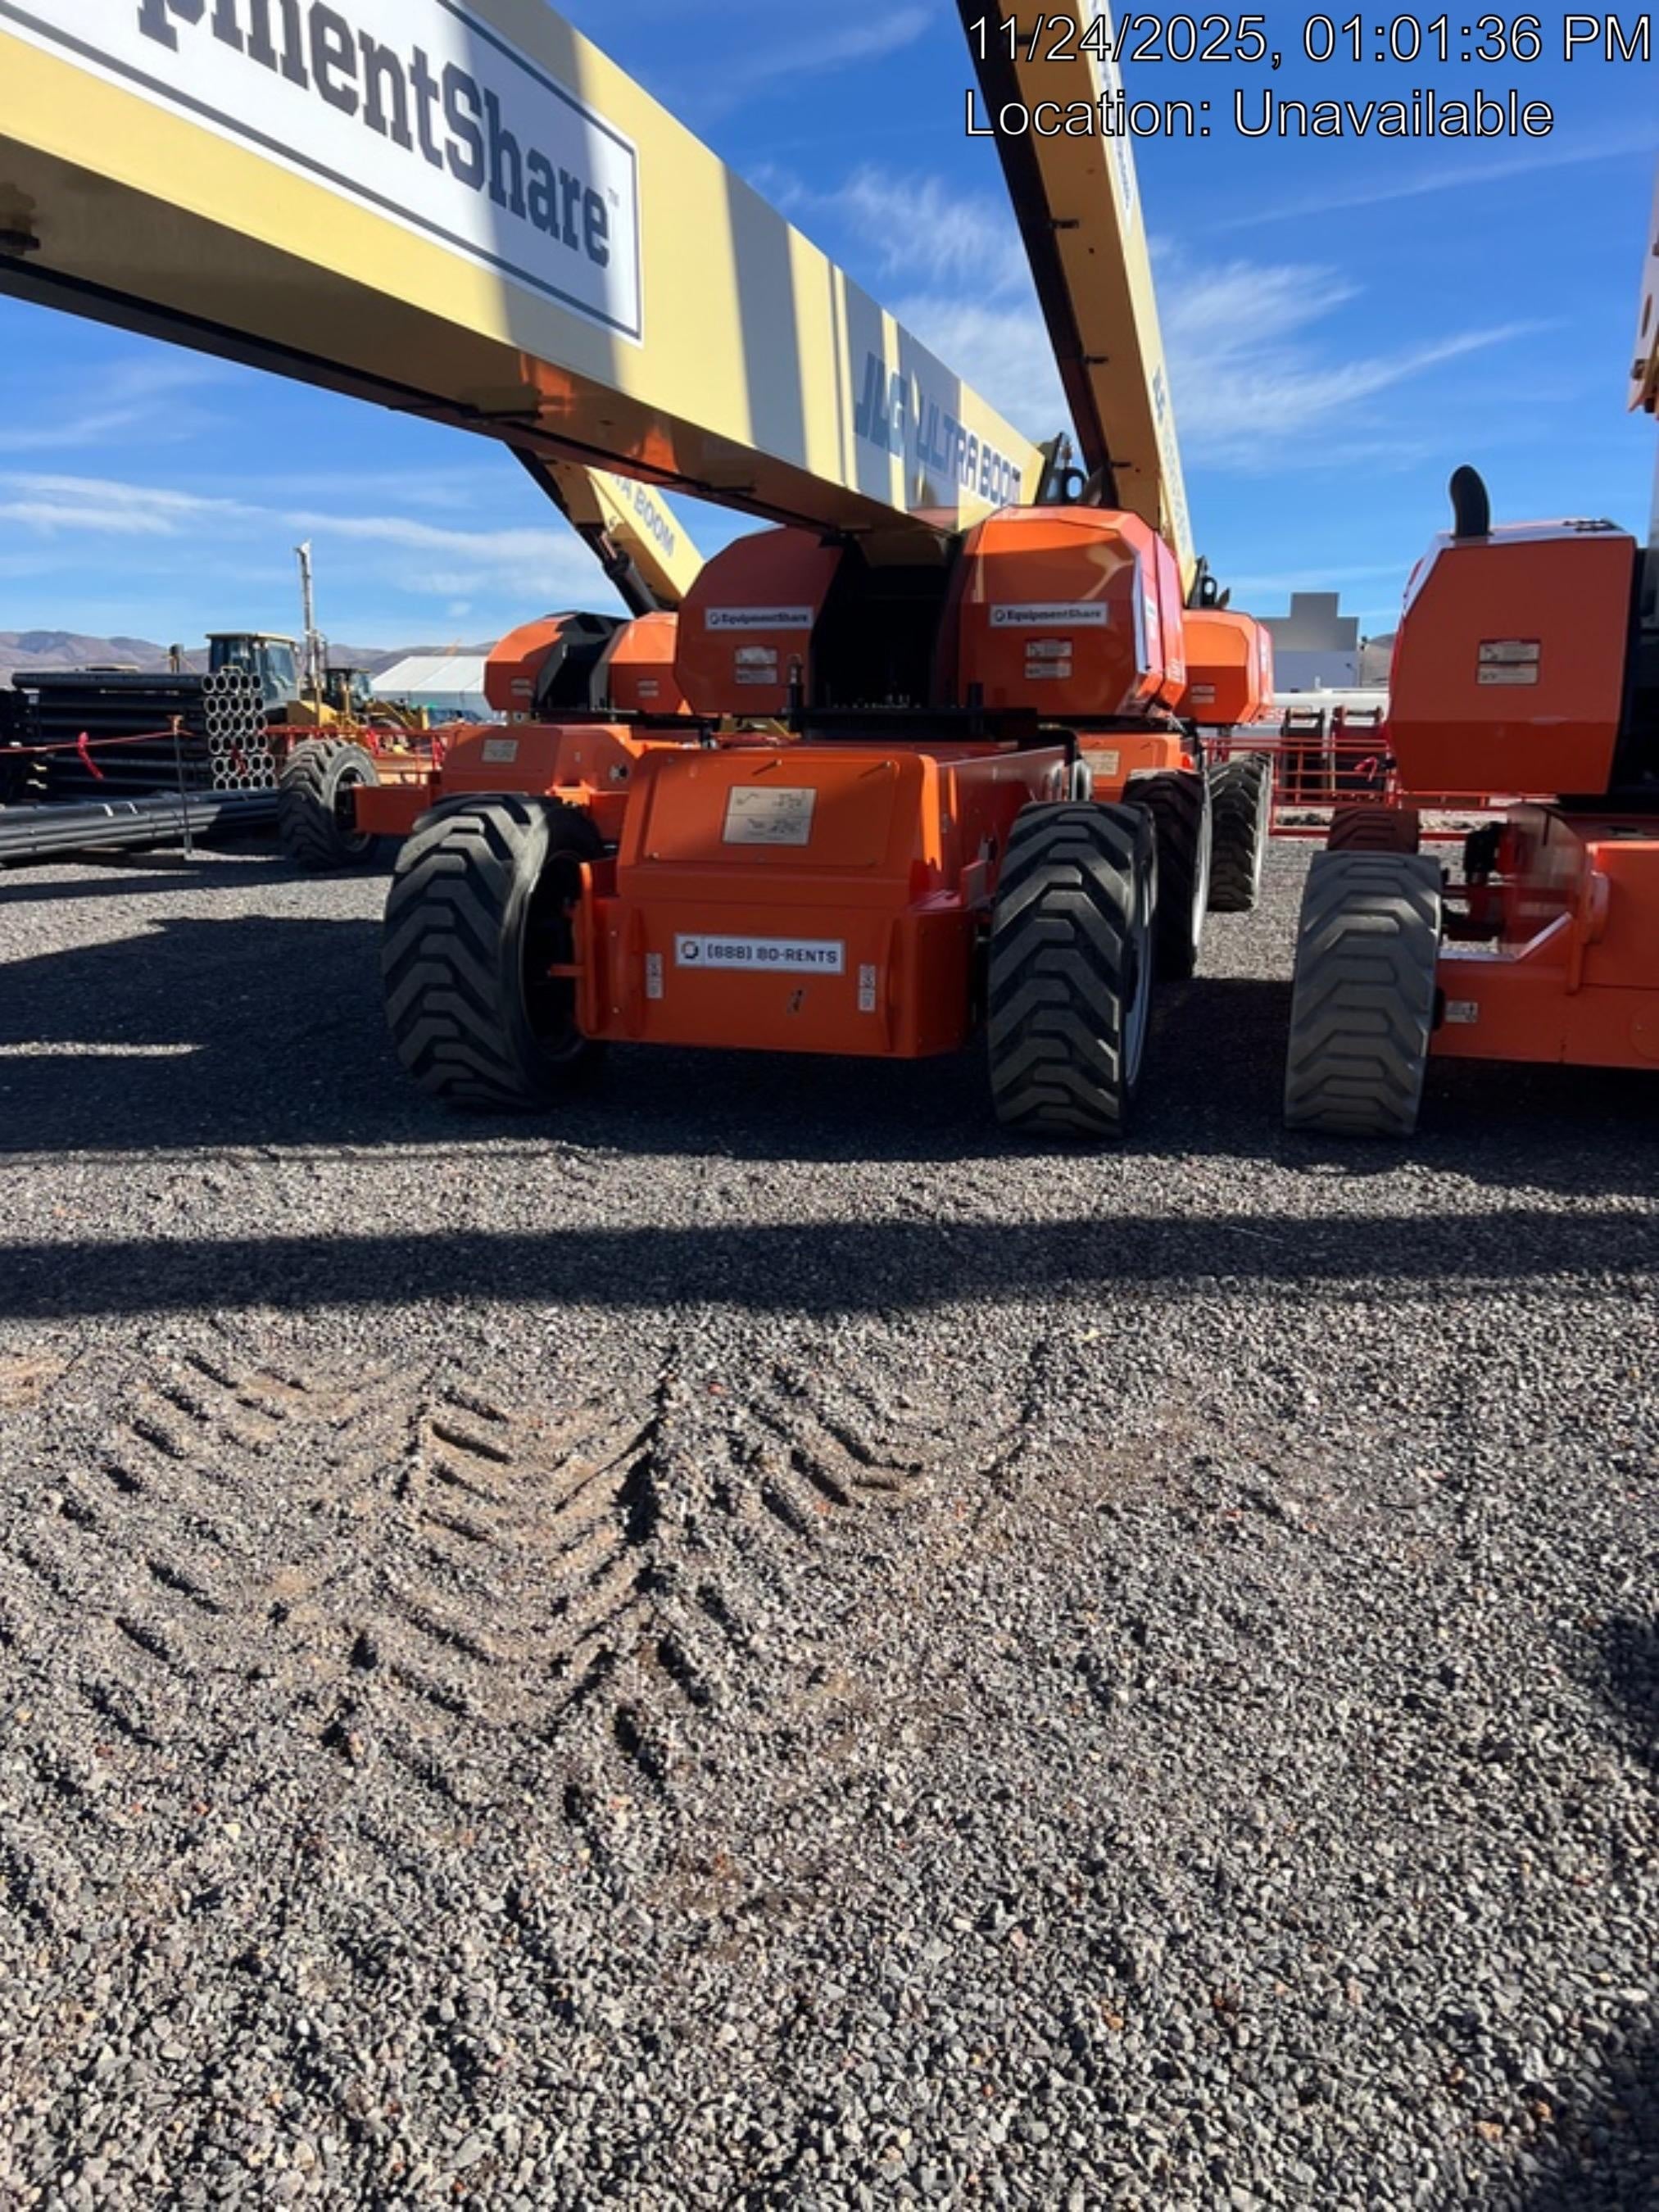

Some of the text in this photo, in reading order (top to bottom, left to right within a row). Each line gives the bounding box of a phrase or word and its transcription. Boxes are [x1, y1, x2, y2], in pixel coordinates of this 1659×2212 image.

[634, 486, 674, 557] BOOM
[1007, 610, 1102, 622] EquipmentShare
[707, 944, 753, 960] (888)
